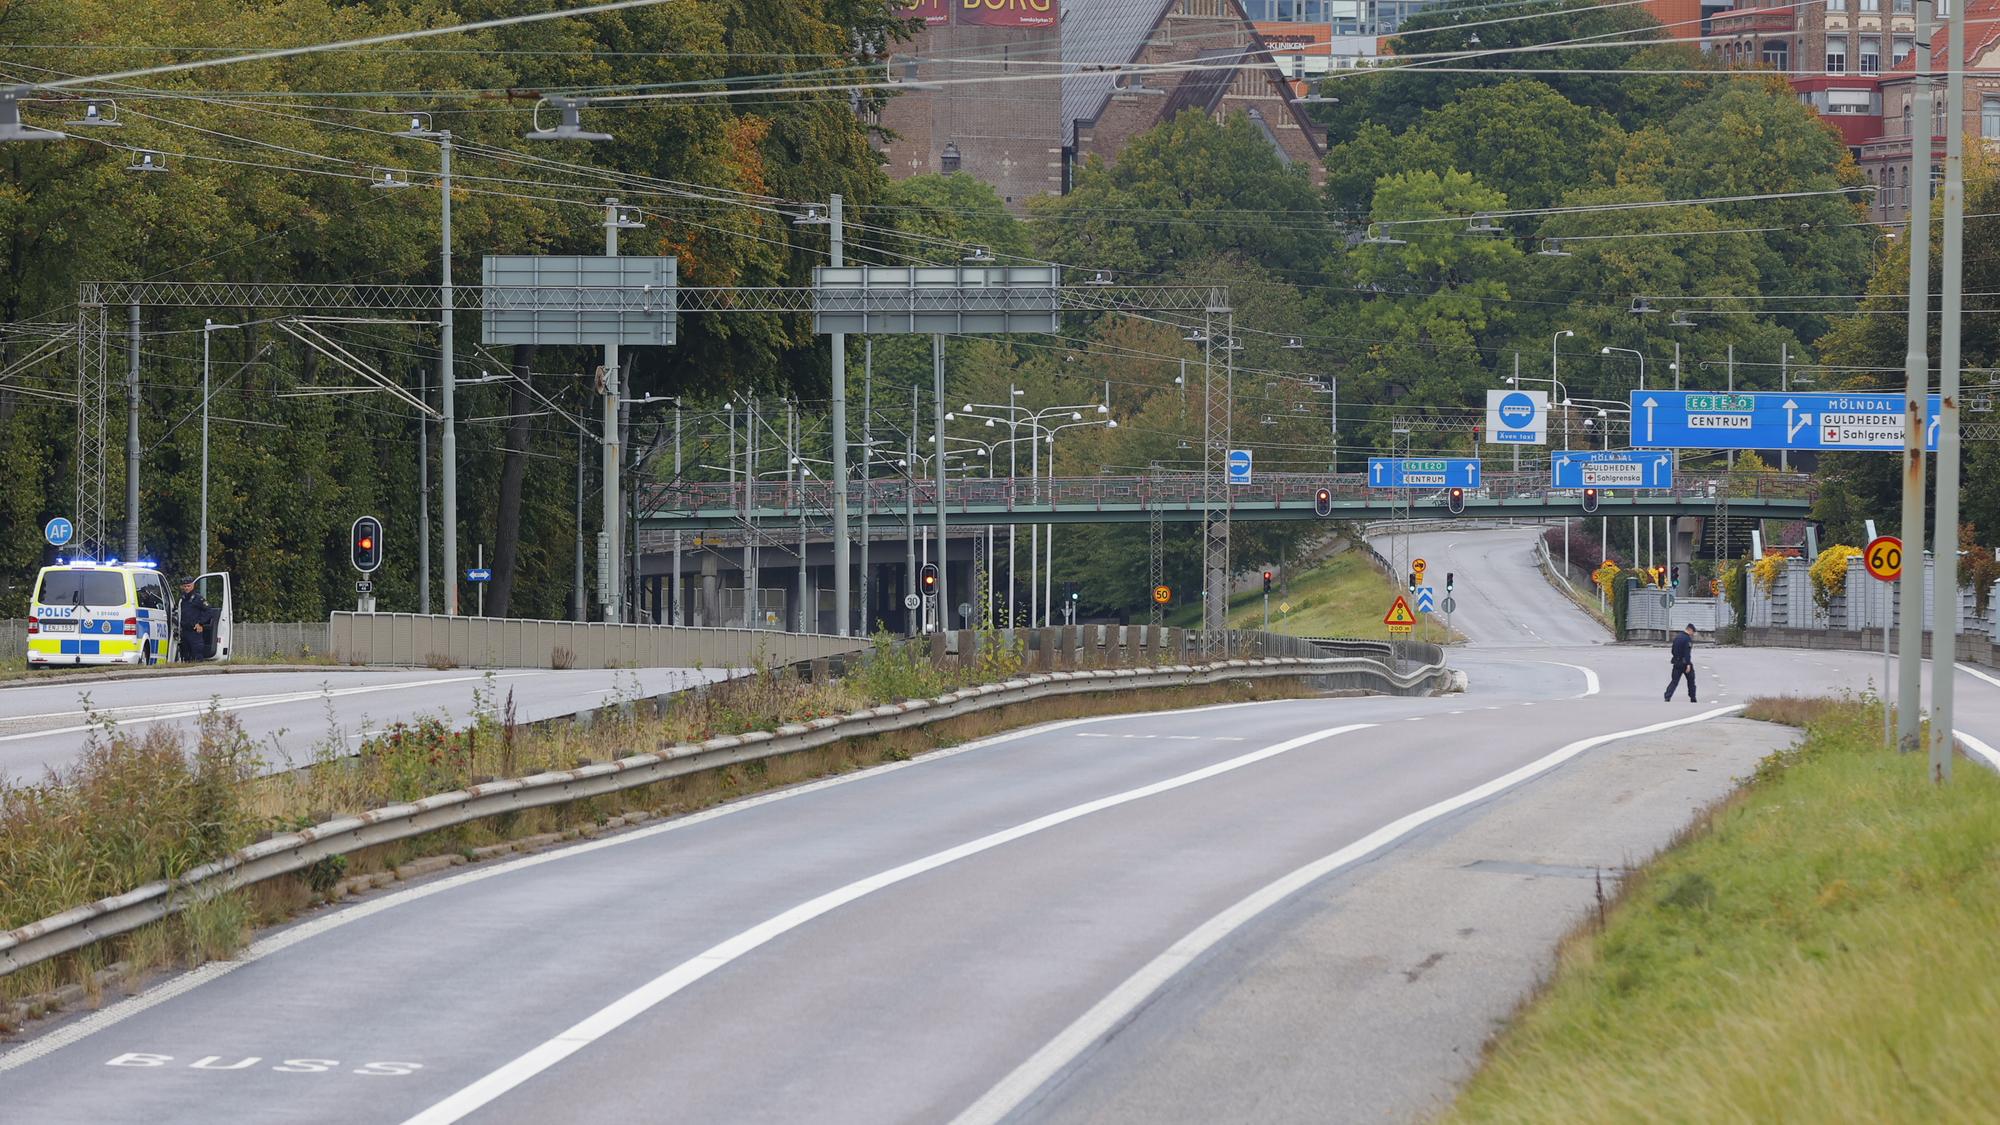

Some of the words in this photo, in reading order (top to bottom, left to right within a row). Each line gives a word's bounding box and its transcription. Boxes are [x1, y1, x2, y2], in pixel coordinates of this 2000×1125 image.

[1692, 399, 1708, 408] E6
[1721, 399, 1747, 408] E0
[1828, 398, 1892, 411] MÖLNDAL
[1691, 416, 1748, 426] CENTRUM
[1824, 415, 1897, 425] GULDHEDEN
[1843, 430, 1906, 442] Sahlgrensk
[1424, 462, 1442, 470] E20
[1597, 474, 1640, 483] Sahlgrenska
[50, 524, 69, 539] AF
[1871, 548, 1902, 570] 60
[1156, 590, 1168, 599] 50
[907, 597, 918, 607] 30
[37, 607, 71, 617] POLIS
[104, 1052, 425, 1076] BUSS
